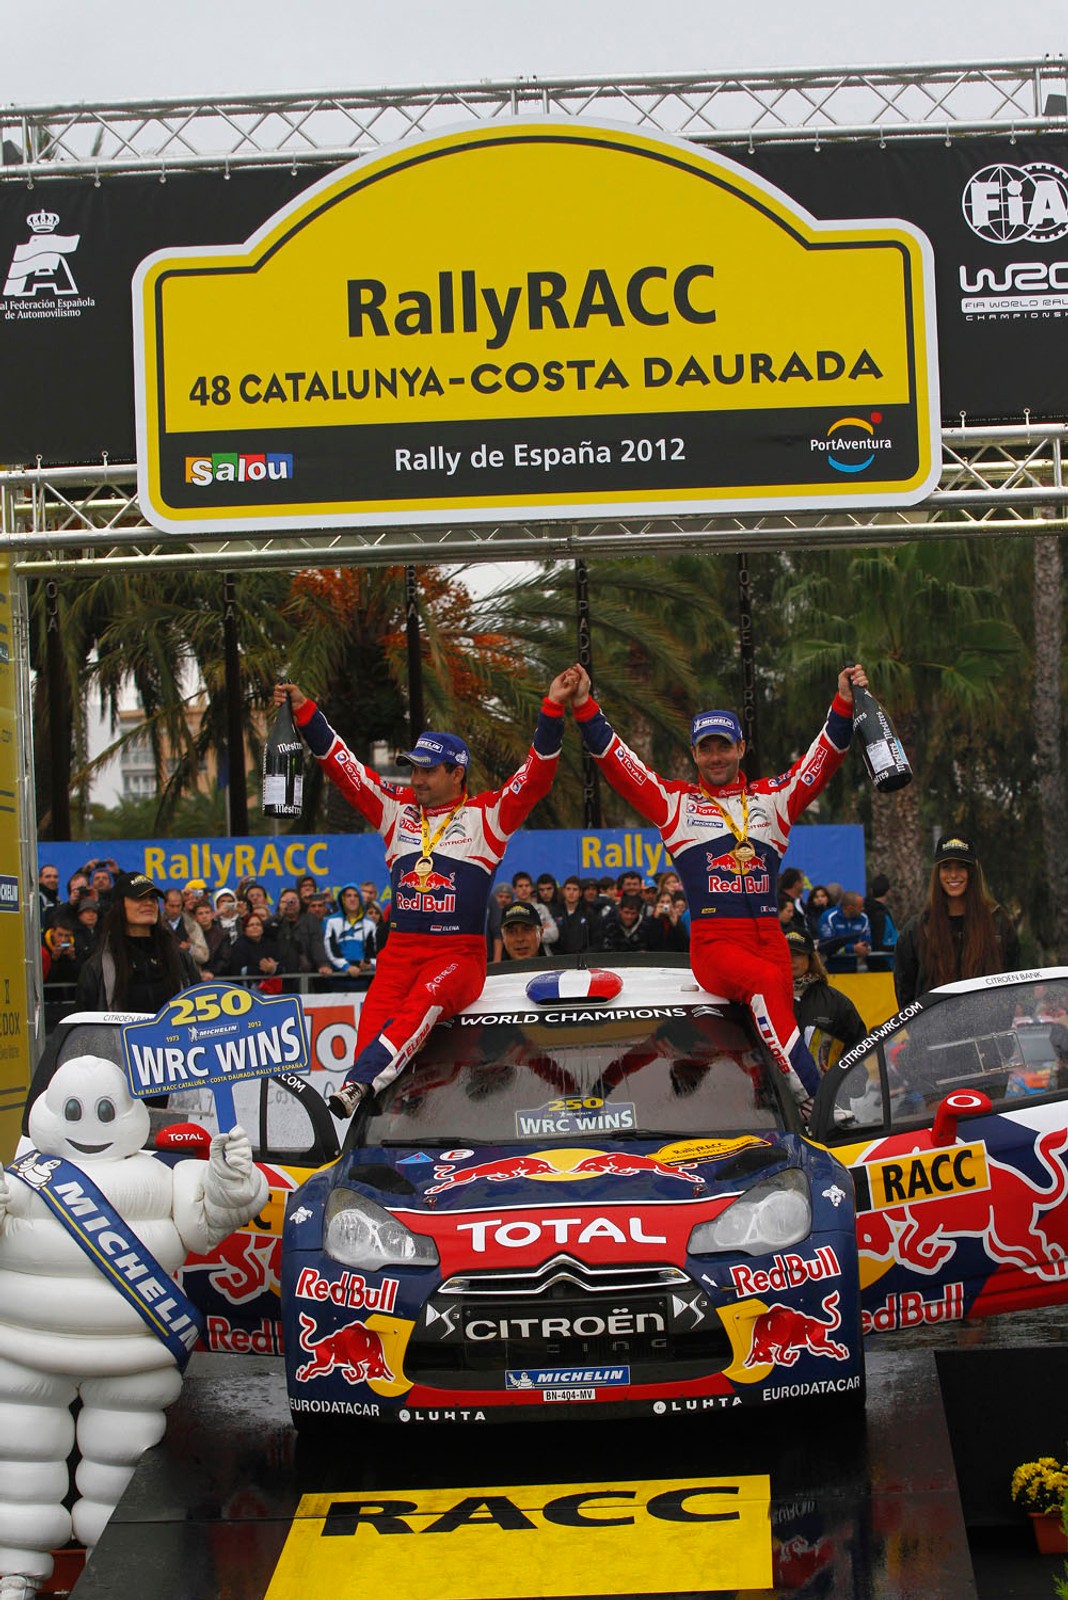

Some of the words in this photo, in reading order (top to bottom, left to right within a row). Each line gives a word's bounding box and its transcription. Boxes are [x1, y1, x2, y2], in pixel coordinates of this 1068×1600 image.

[5, 310, 15, 319] de
[17, 308, 81, 319] Automovilismo
[10, 298, 55, 310] Federación
[57, 297, 95, 309] Española
[346, 264, 717, 350] RallyRACC
[965, 301, 985, 309] FIA
[990, 300, 1038, 308] WORLD
[189, 375, 232, 406] 48
[644, 348, 884, 388] DAURADA
[395, 447, 462, 476] Rally
[470, 444, 504, 469] de
[514, 440, 612, 471] España
[620, 437, 686, 463] 2012
[810, 436, 892, 452] PortAventura
[190, 453, 289, 487] Salou
[623, 757, 644, 783] TOTAL
[144, 843, 329, 888] RallyRACC
[709, 875, 743, 893] Red
[744, 874, 770, 894] Bull
[396, 892, 421, 911] Red
[422, 893, 456, 913] Bull
[1019, 971, 1042, 980] BANK
[169, 989, 252, 1026] 250
[460, 1013, 539, 1026] WORLD
[544, 1007, 688, 1024] CHAMPIONS
[166, 1034, 180, 1043] 1973
[199, 1024, 238, 1037] MICHELIN
[247, 1020, 262, 1029] 2012
[838, 1001, 924, 1069] CITROEN-WRC.COM
[131, 1044, 209, 1087] WRC
[214, 1016, 301, 1073] WINS
[145, 1086, 162, 1095] RALLY
[210, 1075, 227, 1084] COSTA
[256, 1067, 273, 1077] RALLY
[274, 1065, 281, 1073] DE
[547, 1097, 605, 1112] 250
[520, 1117, 570, 1135] WRC
[575, 1110, 633, 1130] WINS
[168, 1133, 204, 1142] TOTAL
[881, 1150, 976, 1203] RACC
[456, 1216, 667, 1252] TOTAL
[53, 1180, 200, 1350] MICHELIN
[730, 1255, 786, 1299] Red
[785, 1245, 842, 1288] Bull
[296, 1267, 349, 1307] Red
[347, 1273, 400, 1315] Bull
[899, 1281, 964, 1329] Bull
[207, 1315, 276, 1355] Red
[537, 1370, 624, 1383] MICHELIN
[763, 1375, 861, 1401] EURODATACAR
[289, 1397, 380, 1418] EURODATACAR
[546, 1390, 593, 1400] BN-404-MV
[671, 1396, 743, 1411] LUHTA
[415, 1410, 486, 1422] LUHTA
[321, 1486, 740, 1538] RACC
